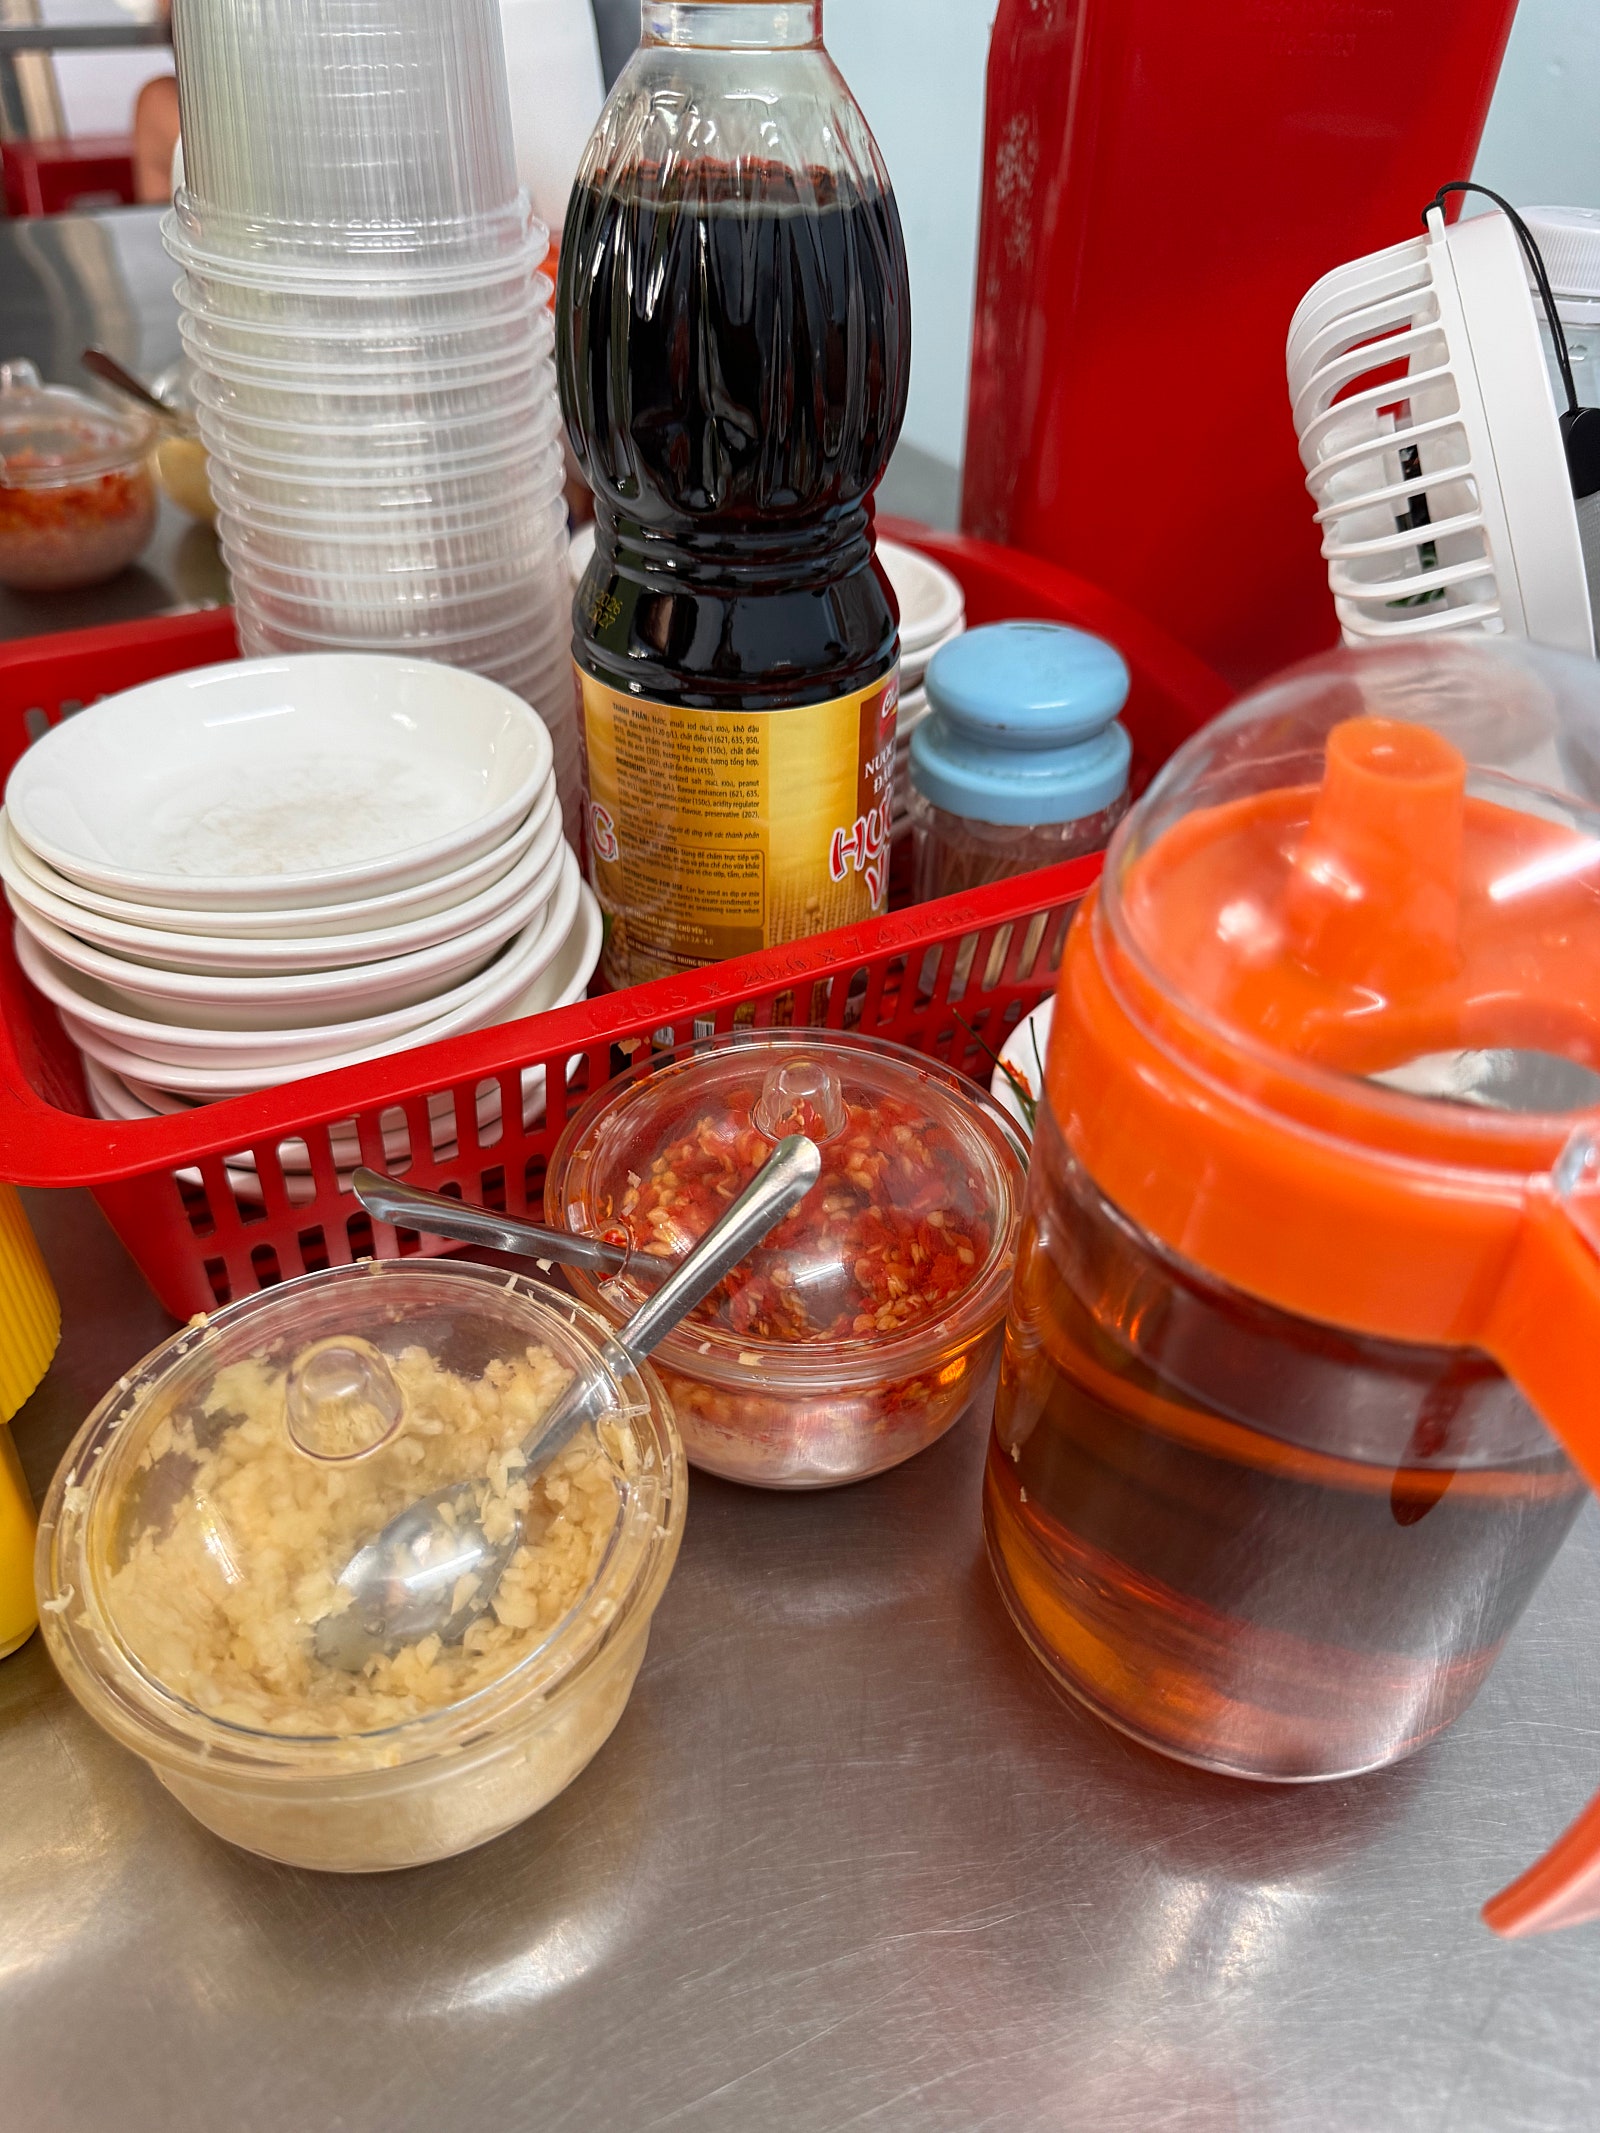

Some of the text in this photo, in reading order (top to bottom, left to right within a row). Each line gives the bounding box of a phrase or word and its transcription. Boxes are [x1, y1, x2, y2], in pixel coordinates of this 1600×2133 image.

[714, 735, 731, 745] (621,
[731, 735, 745, 745] 635,
[746, 735, 760, 745] 950,
